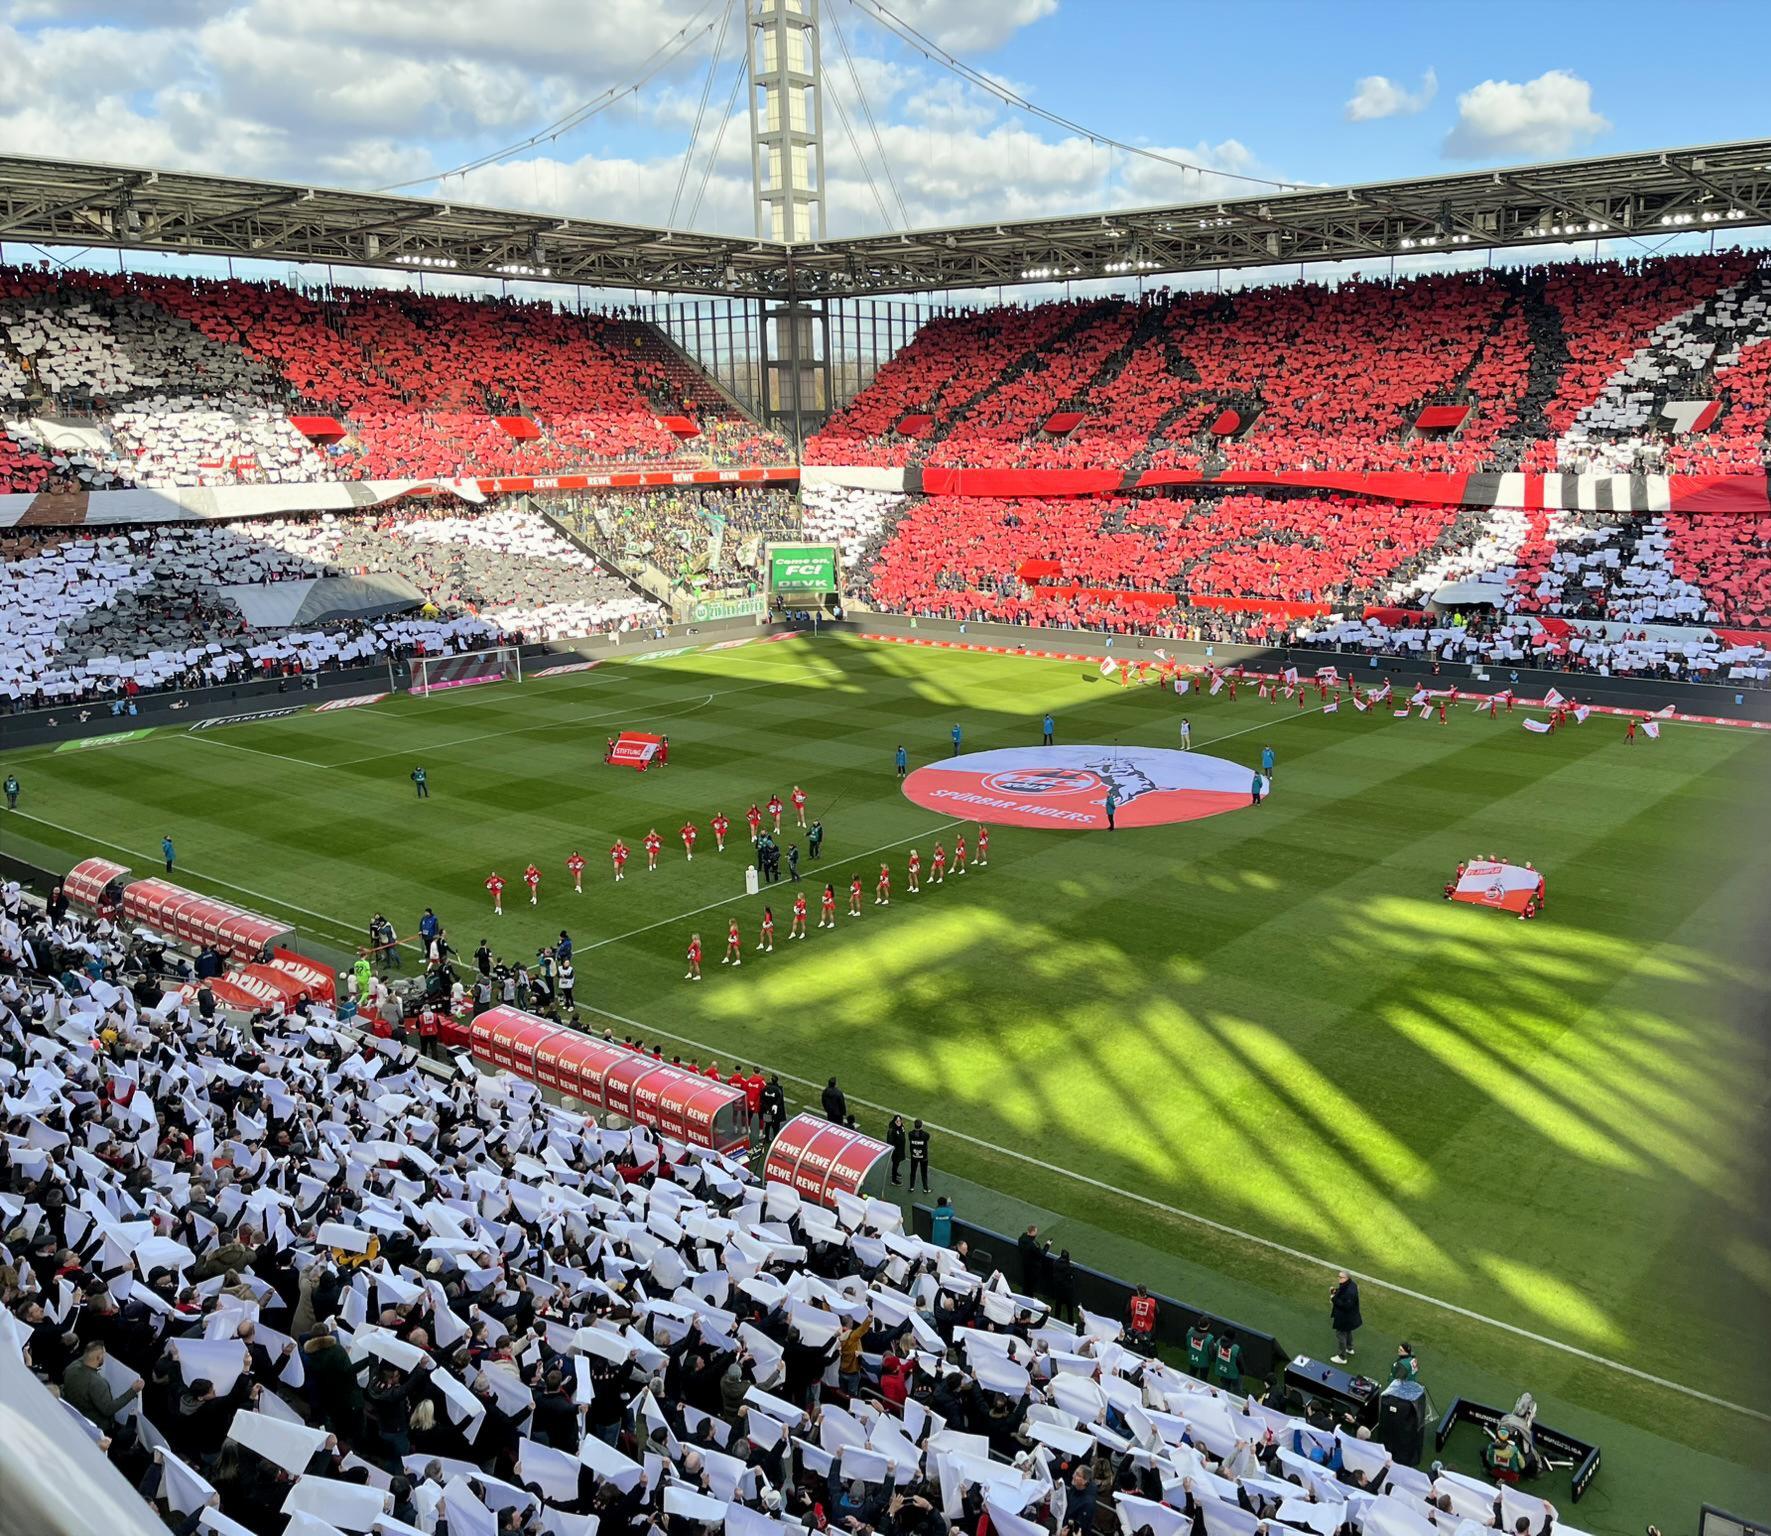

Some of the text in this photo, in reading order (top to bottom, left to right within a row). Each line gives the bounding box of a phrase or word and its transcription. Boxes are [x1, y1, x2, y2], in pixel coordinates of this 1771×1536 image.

[533, 478, 559, 488] REWE
[586, 475, 611, 486] REWE
[672, 472, 695, 482] REWE
[719, 471, 741, 481] REWE
[785, 565, 823, 576] FC!
[616, 747, 642, 756] STIFTUNG
[929, 789, 1096, 824] SPÜRBAR ANDERS.
[270, 959, 327, 988] REWE
[226, 971, 281, 1002] REWE
[472, 1025, 491, 1039] REWE
[493, 1033, 512, 1047] REWE
[473, 1044, 491, 1057] REWE
[514, 1041, 534, 1055] REWE
[494, 1053, 512, 1066] REWE
[537, 1050, 556, 1064] REWE
[632, 1058, 657, 1068] REWE
[515, 1061, 534, 1074] REWE
[559, 1058, 578, 1073] REWE
[537, 1070, 556, 1084] REWE
[581, 1067, 602, 1082] REWE
[658, 1068, 685, 1079] REWE
[559, 1079, 579, 1093] REWE
[608, 1078, 629, 1093] REWE
[684, 1077, 710, 1088] REWE
[582, 1088, 602, 1102] REWE
[636, 1087, 657, 1103] REWE
[711, 1086, 737, 1098] REWE
[609, 1098, 629, 1113] REWE
[660, 1097, 683, 1113] REWE
[636, 1109, 656, 1124] REWE
[687, 1107, 710, 1123] REWE
[661, 1119, 683, 1135] REWE
[798, 1116, 828, 1129] REWE
[687, 1130, 710, 1145] REWE
[826, 1126, 855, 1139] REWE
[774, 1140, 801, 1157] REWE
[857, 1138, 887, 1152] REWE
[804, 1151, 831, 1168] REWE
[766, 1163, 792, 1181] REWE
[834, 1163, 861, 1181] REWE
[795, 1175, 821, 1193] REWE
